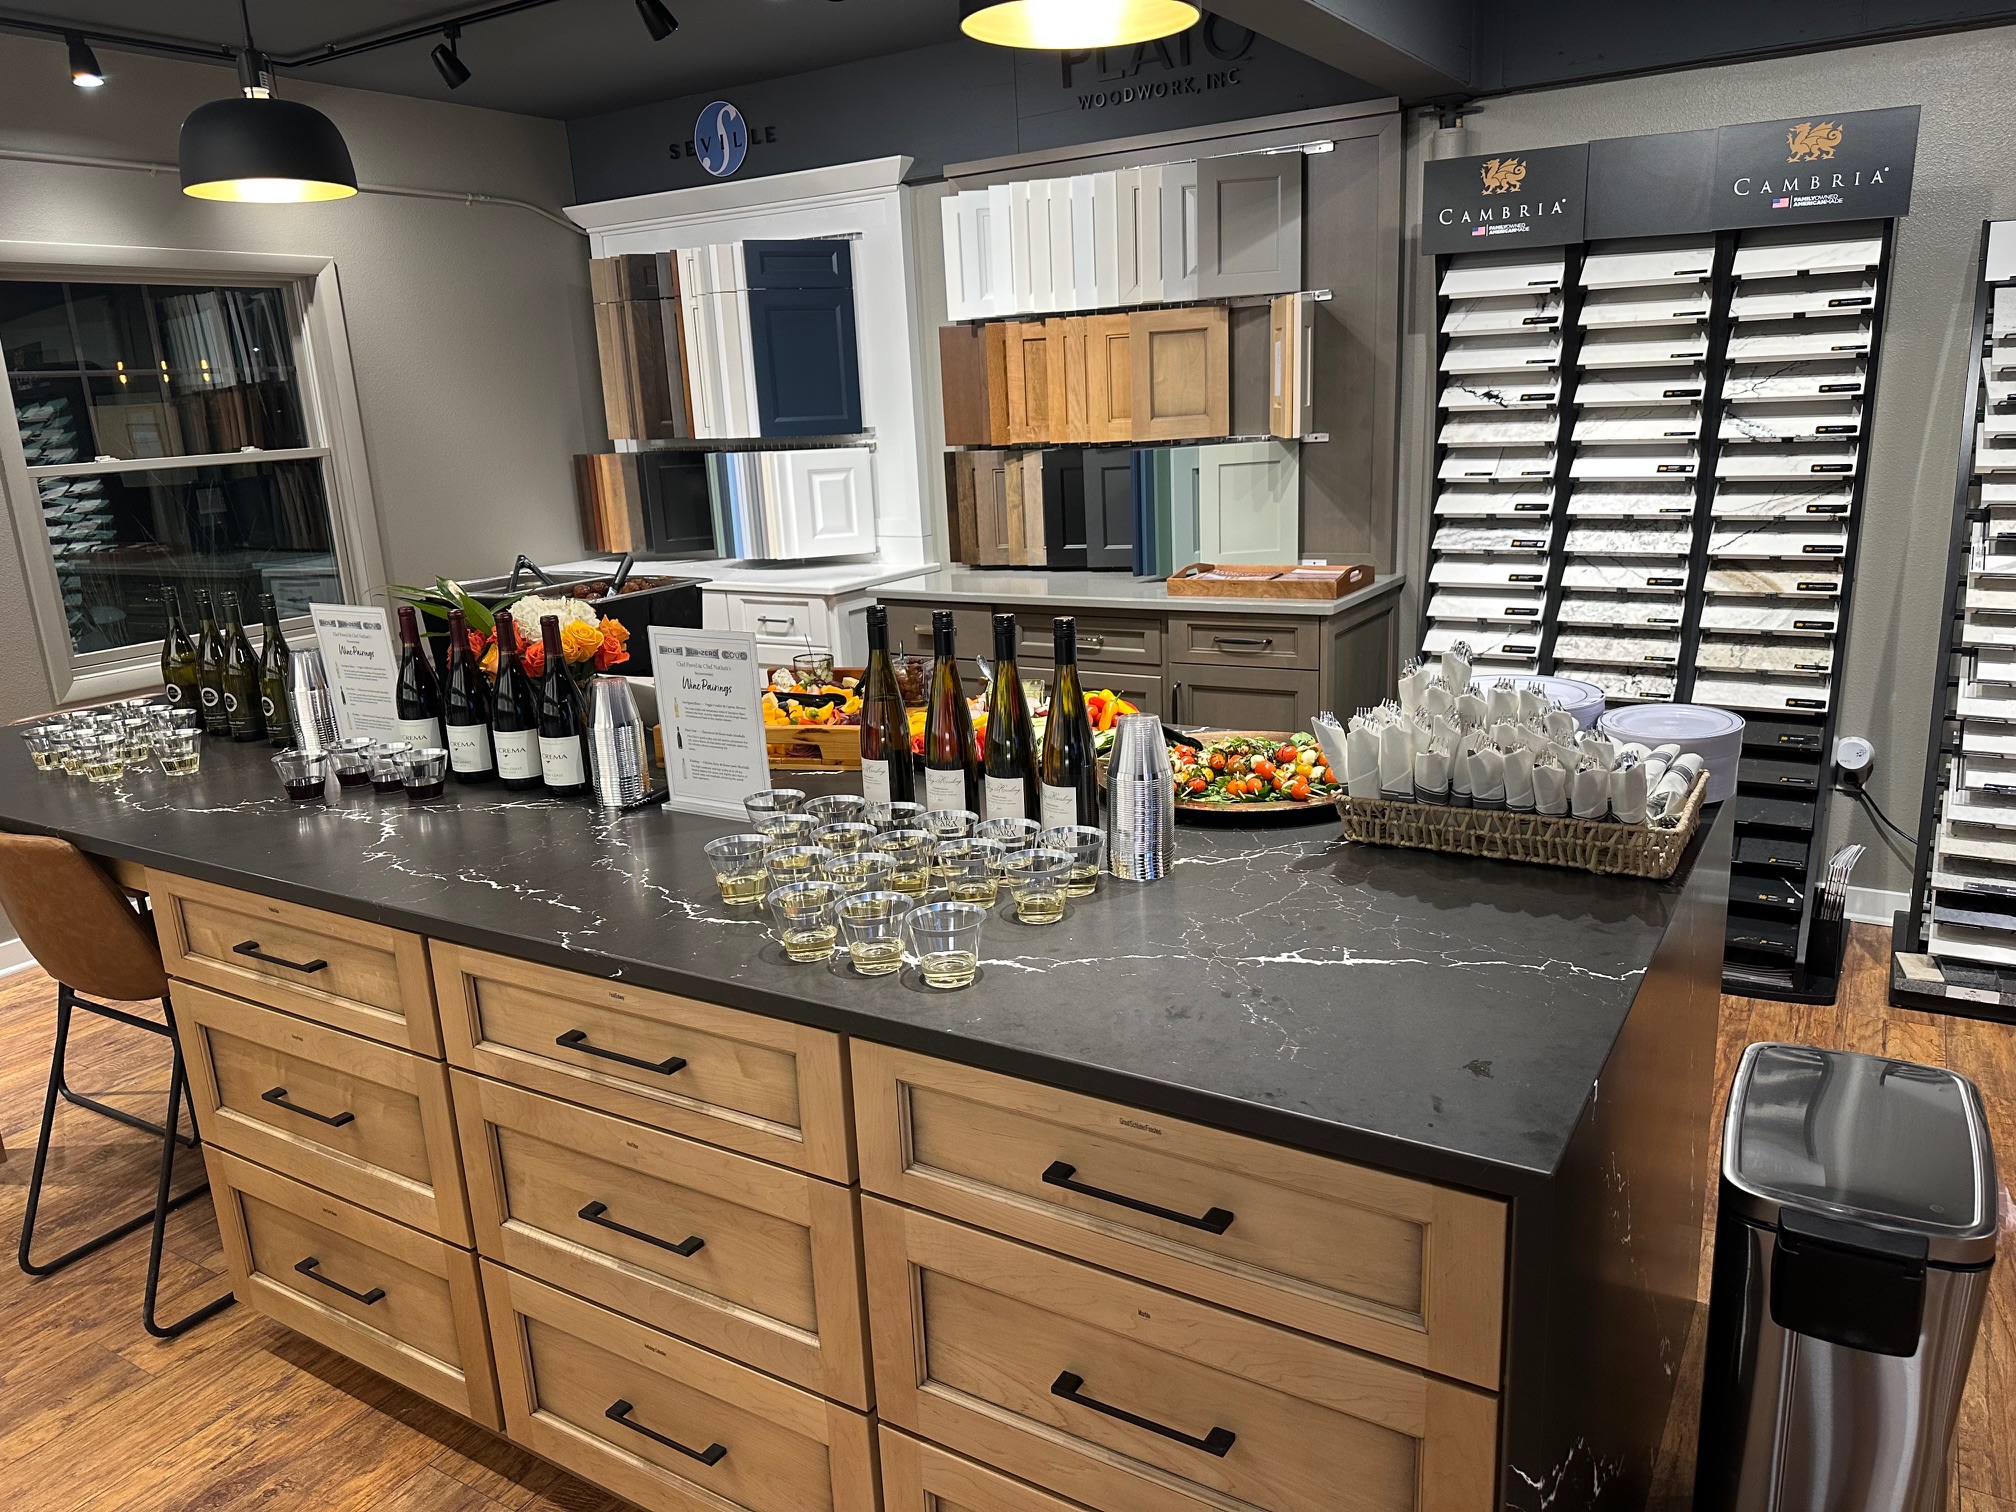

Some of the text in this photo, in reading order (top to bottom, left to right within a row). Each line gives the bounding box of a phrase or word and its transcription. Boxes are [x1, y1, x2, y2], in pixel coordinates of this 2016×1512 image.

[1078, 68, 1240, 110] WOODWORK, INC
[669, 126, 778, 160] SEVILLE
[682, 676, 732, 696] Wine Pairings
